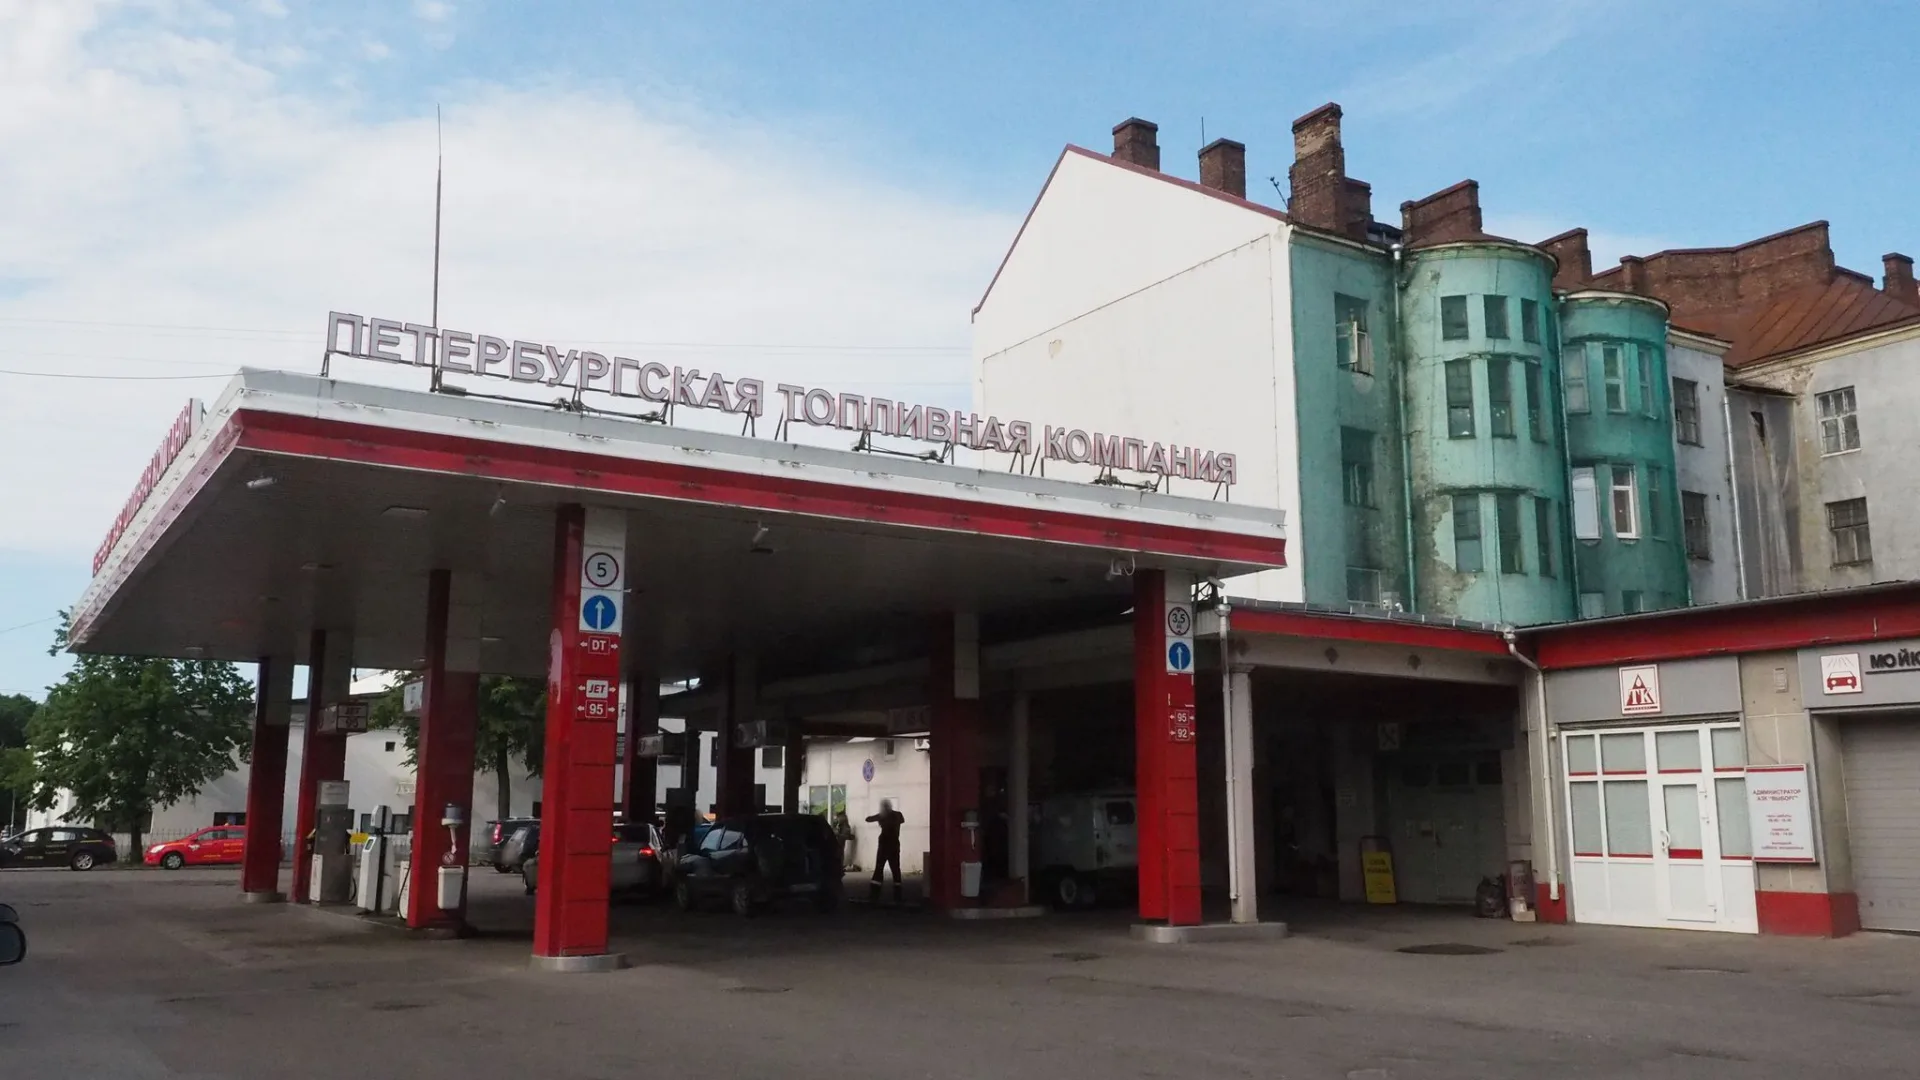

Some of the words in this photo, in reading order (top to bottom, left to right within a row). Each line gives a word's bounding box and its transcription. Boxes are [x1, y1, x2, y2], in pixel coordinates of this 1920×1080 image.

[326, 311, 764, 418] ПЕТЕРБУРГСКАЯ
[776, 383, 1032, 456] ТОПЛИВНАЯ
[1044, 424, 1237, 486] КОМПАНИЯ
[596, 562, 607, 578] 5
[591, 639, 606, 651] DT
[588, 684, 606, 694] JET
[589, 703, 604, 715] 95
[1177, 713, 1187, 723] 95
[1177, 728, 1188, 738] 92
